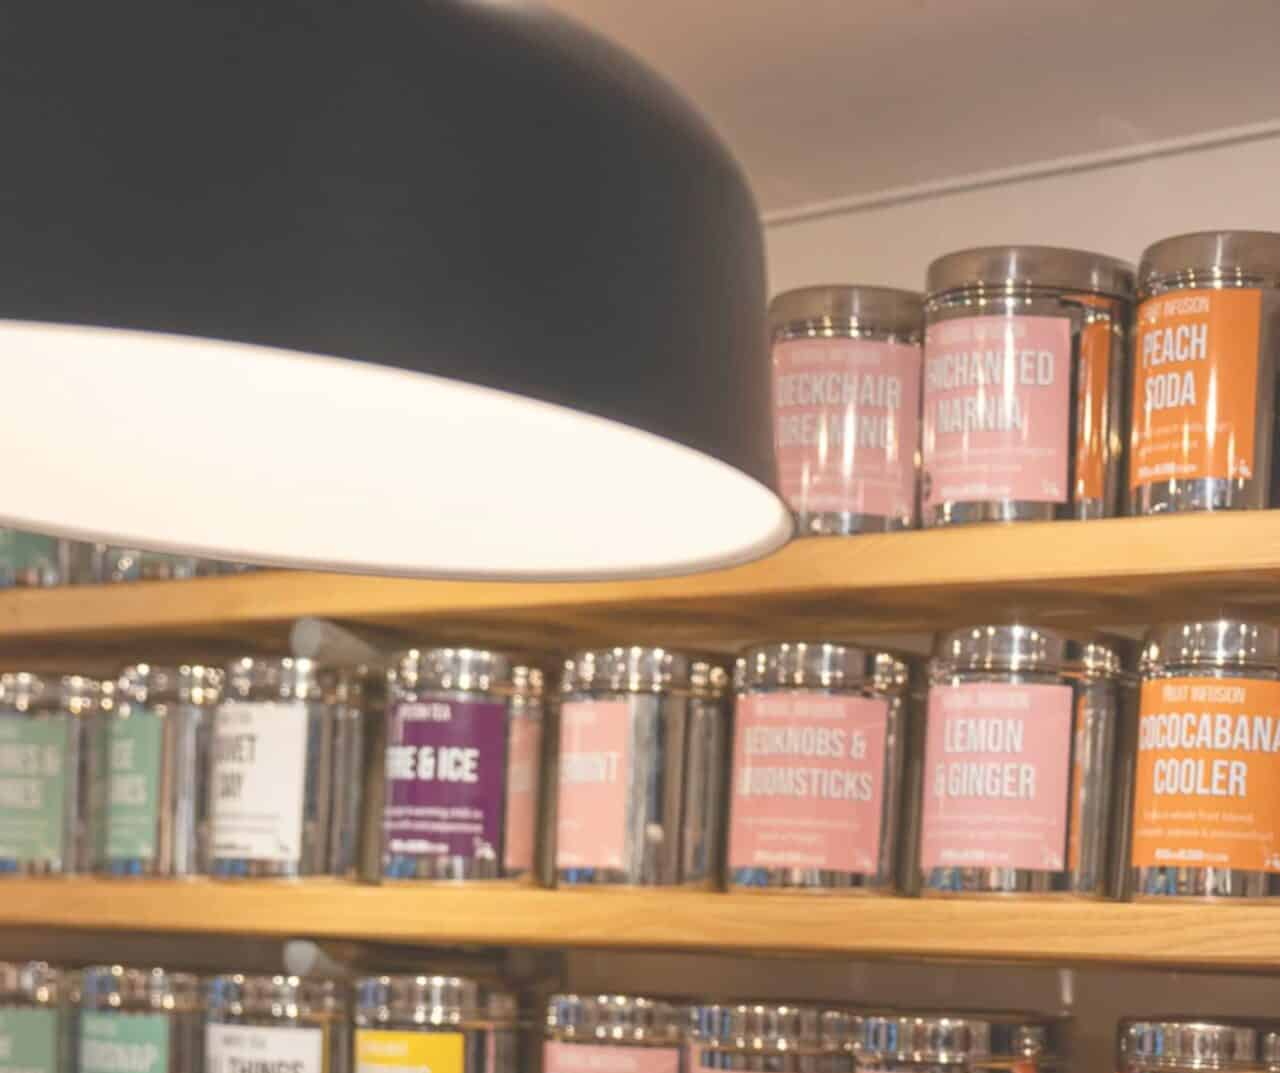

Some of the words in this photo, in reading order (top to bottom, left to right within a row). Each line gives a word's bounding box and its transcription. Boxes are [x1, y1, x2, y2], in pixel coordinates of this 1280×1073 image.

[1143, 322, 1208, 368] PEACH
[1144, 371, 1196, 412] SODA
[944, 718, 1024, 753] LEMON
[438, 746, 480, 783] ICE
[947, 762, 1035, 800] GINGER
[1153, 758, 1248, 799] COOLER
